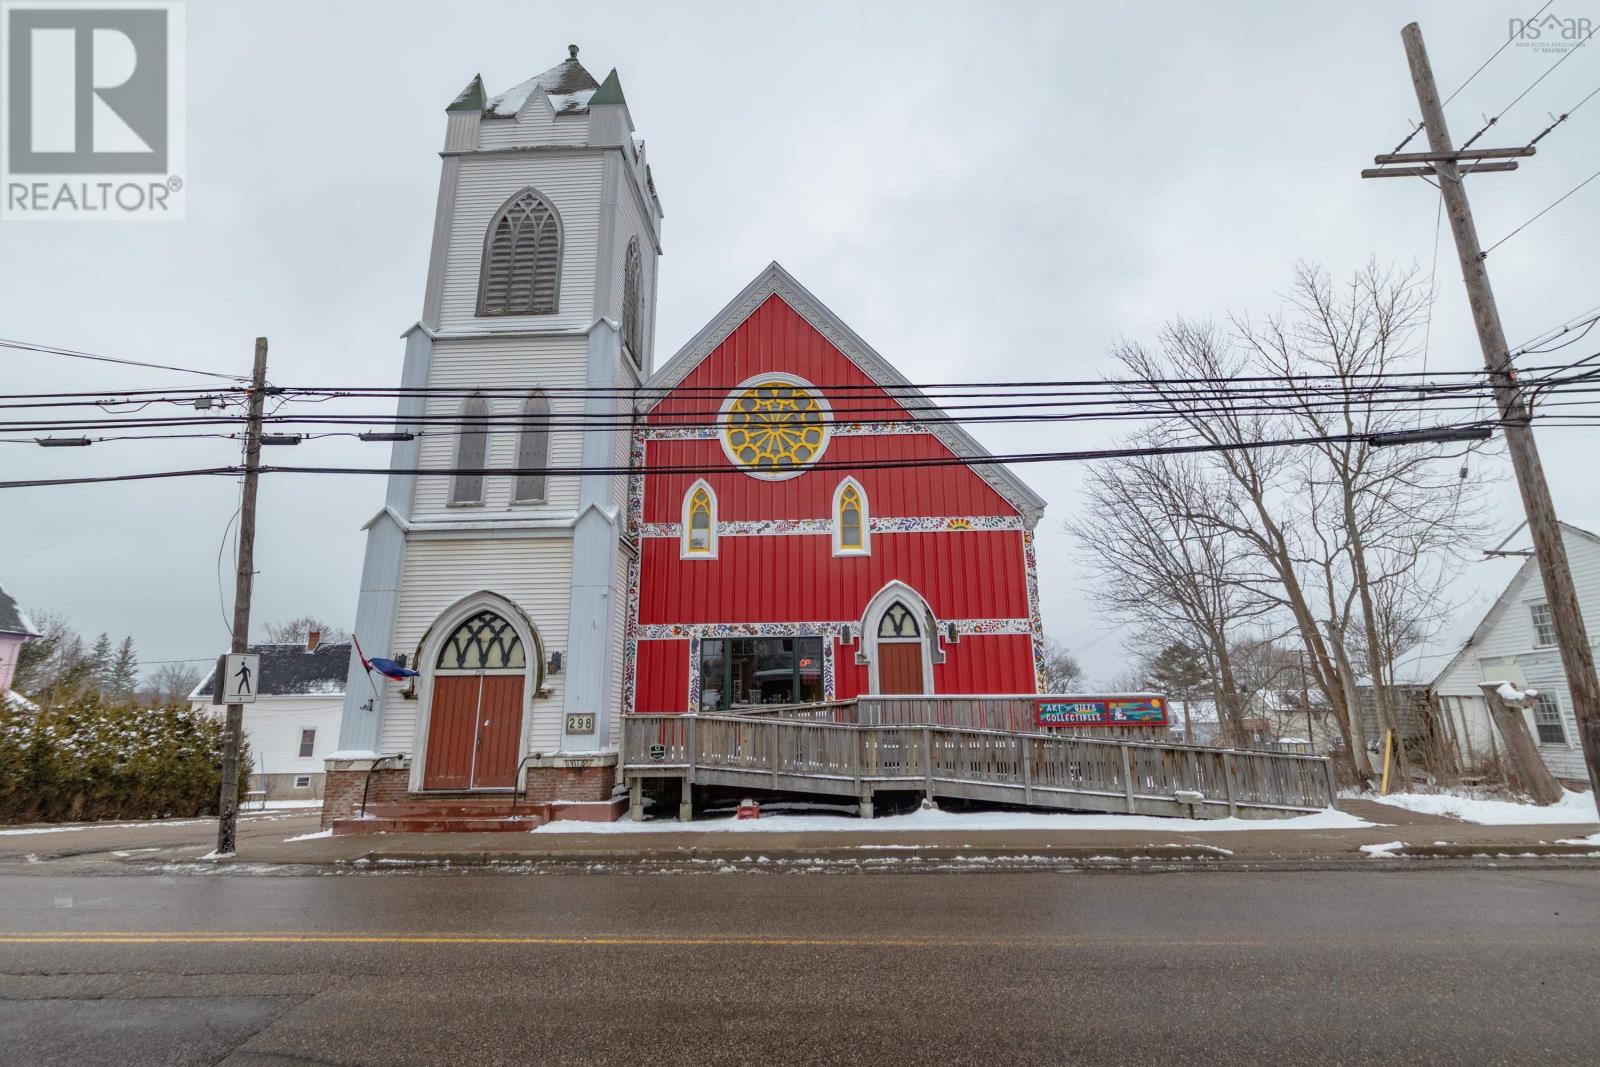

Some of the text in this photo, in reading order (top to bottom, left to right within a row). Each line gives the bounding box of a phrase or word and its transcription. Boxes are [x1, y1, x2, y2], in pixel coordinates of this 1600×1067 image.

[1074, 704, 1097, 712] GIFTS
[1046, 713, 1101, 722] COLLECTIBLES
[569, 717, 592, 729] 298
